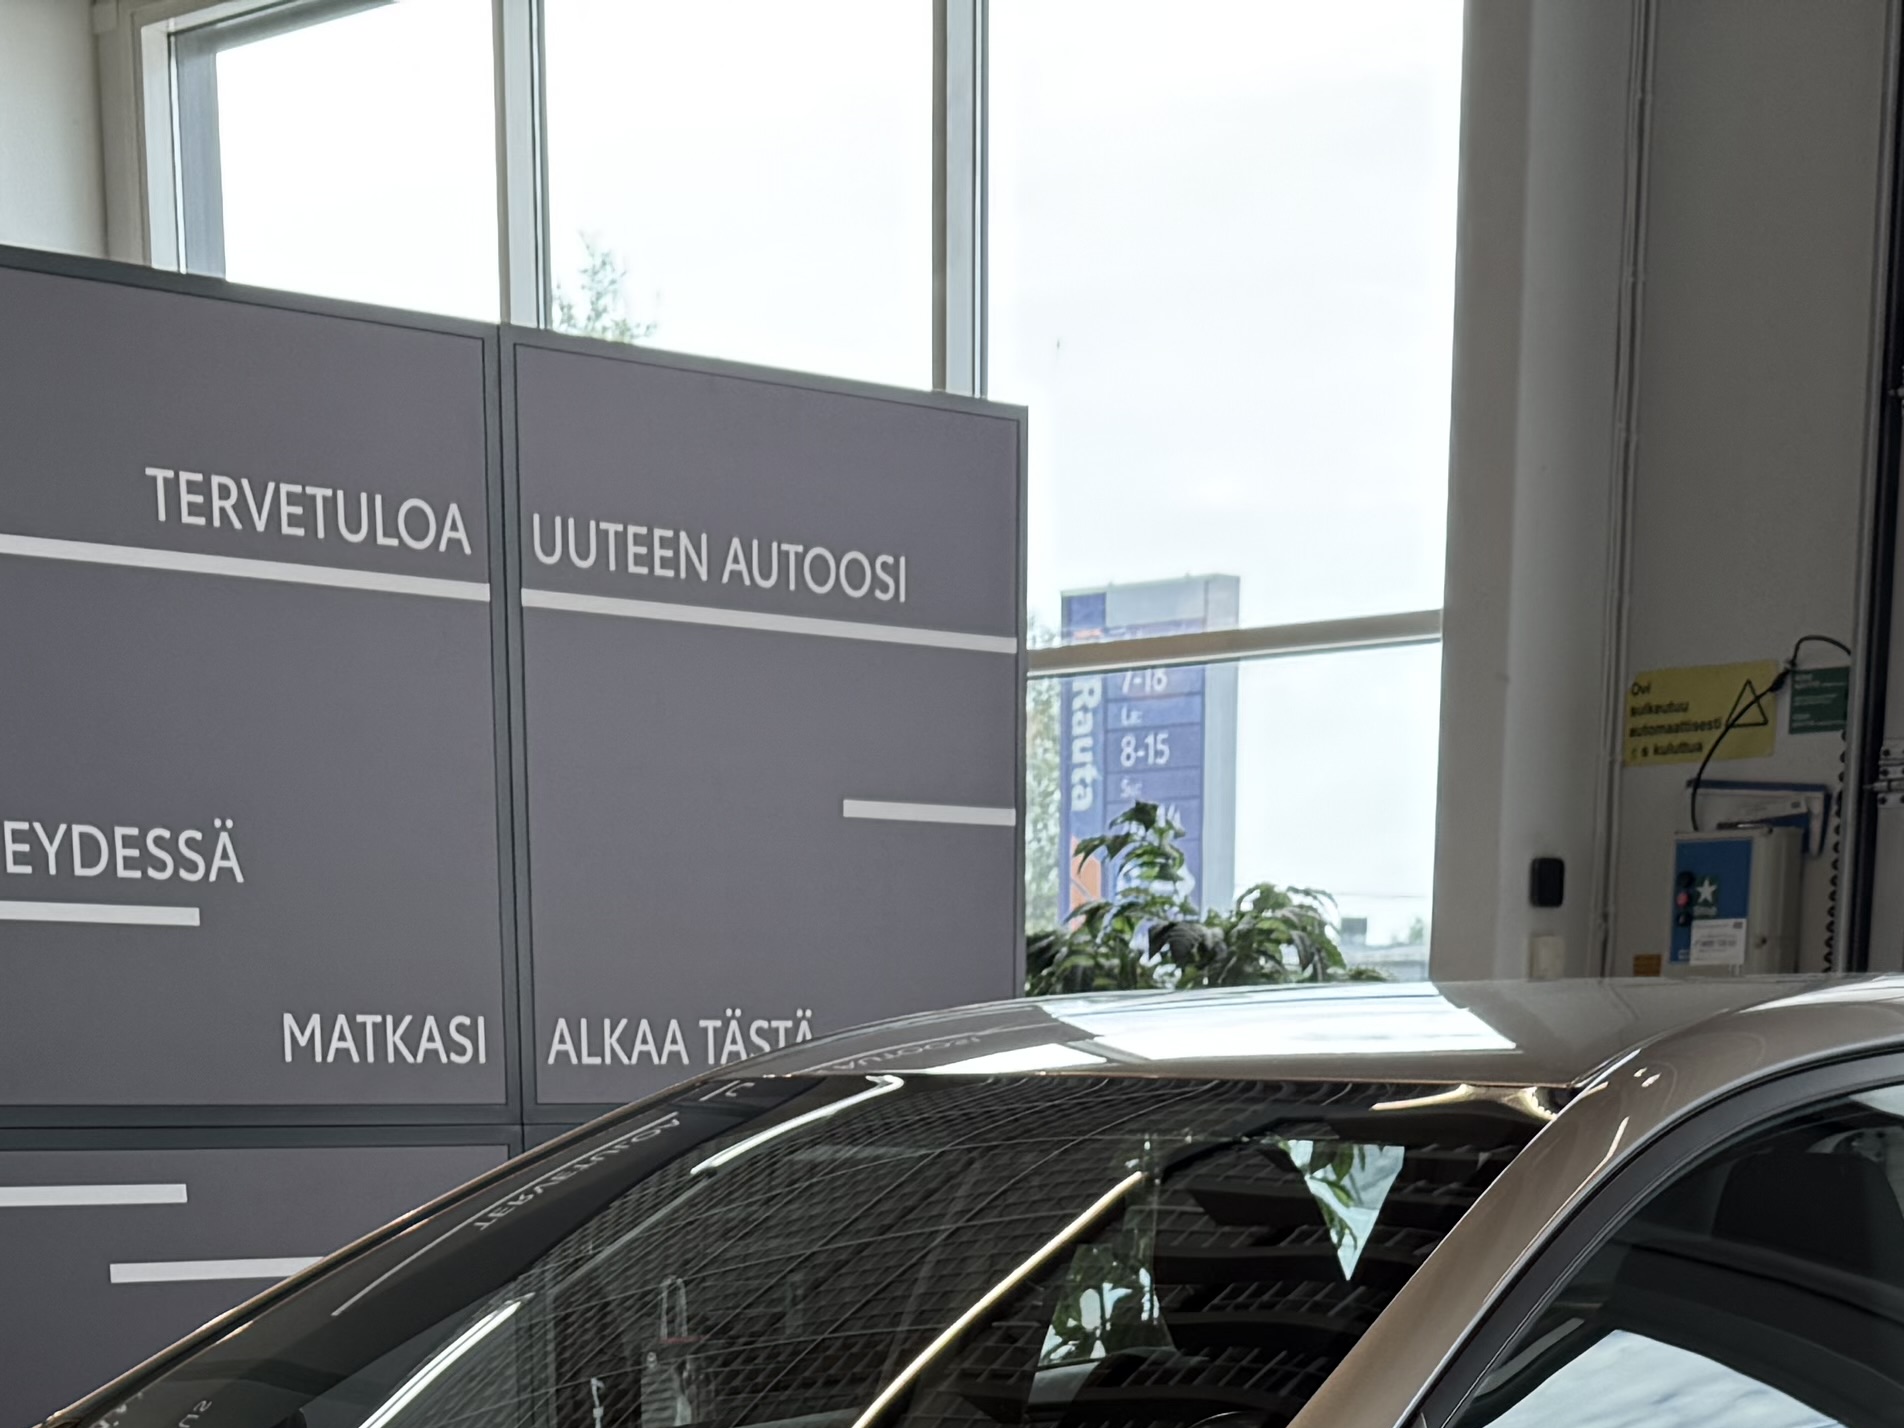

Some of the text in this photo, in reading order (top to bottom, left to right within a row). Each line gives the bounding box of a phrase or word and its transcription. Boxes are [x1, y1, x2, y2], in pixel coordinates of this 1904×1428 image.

[144, 466, 907, 604] TERVETULOA UUTEEN AUTOOSI
[1070, 677, 1103, 813] Rauta
[1120, 733, 1170, 767] 8-15
[282, 1007, 813, 1065] MATKASI ALKAA TÄSTÄ
